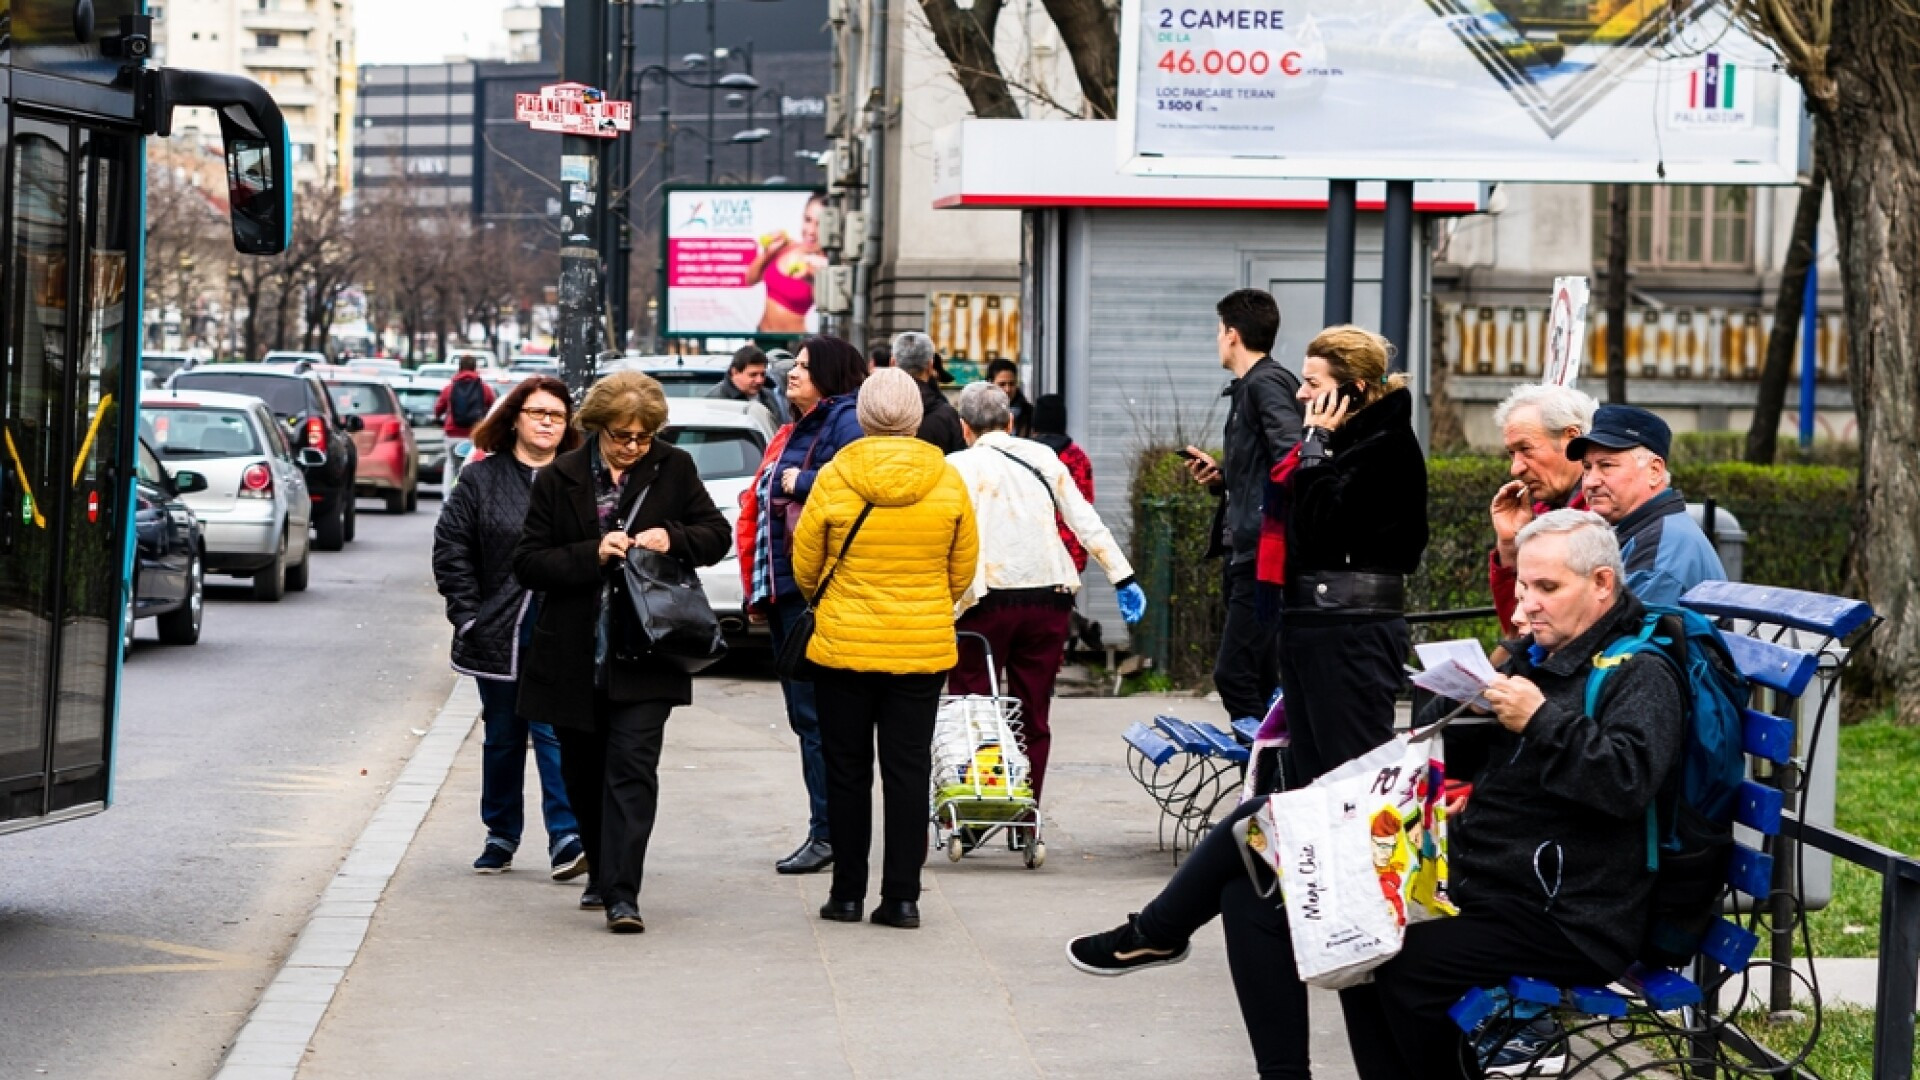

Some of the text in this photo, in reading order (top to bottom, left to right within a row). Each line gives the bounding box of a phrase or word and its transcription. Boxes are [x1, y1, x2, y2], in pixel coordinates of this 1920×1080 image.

[1159, 9, 1284, 29] 2 CAMERE
[1158, 33, 1191, 43] DE LA
[1157, 50, 1302, 75] 46.000 €
[1156, 87, 1276, 99] LOC PARCARE TERAN
[1674, 111, 1745, 123] PALLADIUM
[711, 199, 751, 214] VIVA
[711, 215, 753, 227] SPORT
